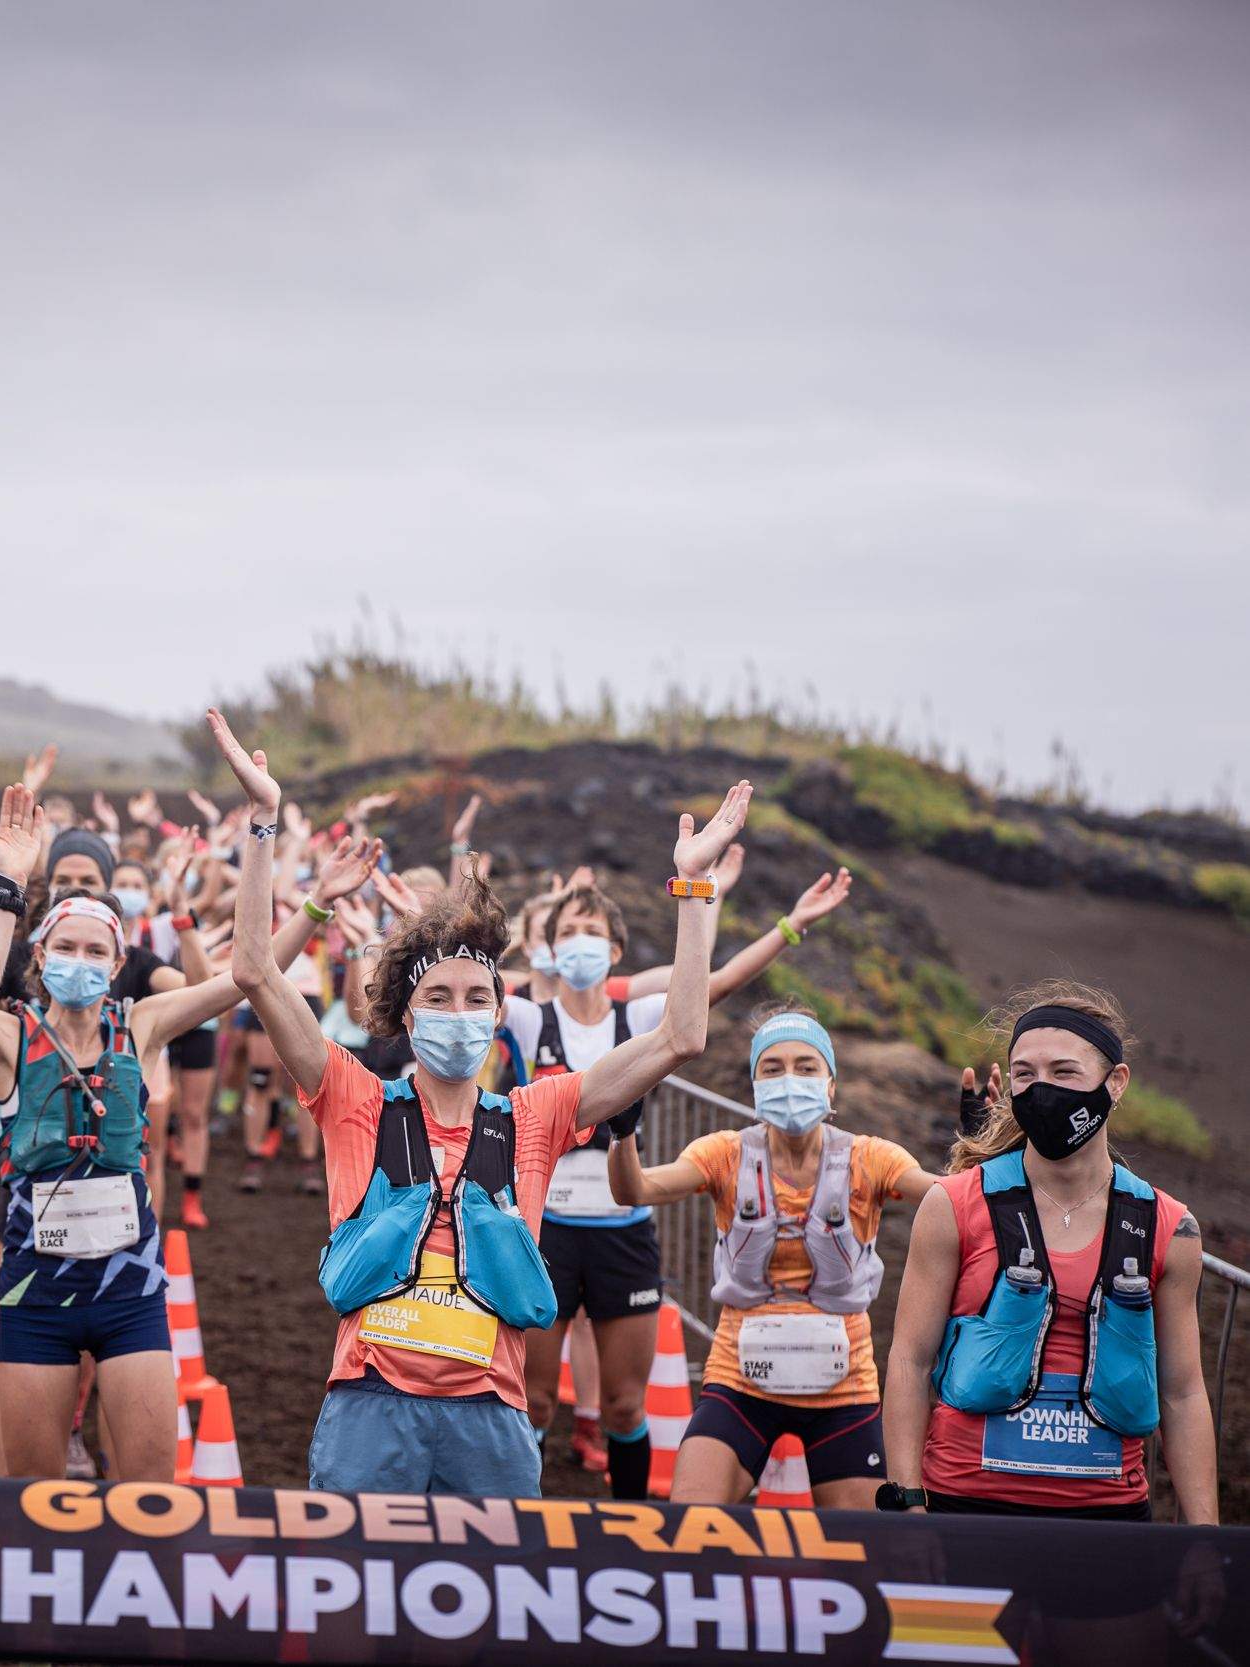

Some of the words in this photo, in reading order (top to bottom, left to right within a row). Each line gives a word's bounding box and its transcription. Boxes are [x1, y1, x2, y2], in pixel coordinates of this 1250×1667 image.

[39, 1229, 68, 1239] STAGE
[40, 1239, 64, 1248] RACE
[368, 1303, 421, 1323] OVERALL
[365, 1313, 409, 1332] LEADER
[744, 1361, 774, 1370] STAGE
[745, 1370, 769, 1379] RACE
[1022, 1423, 1089, 1444] LEADER
